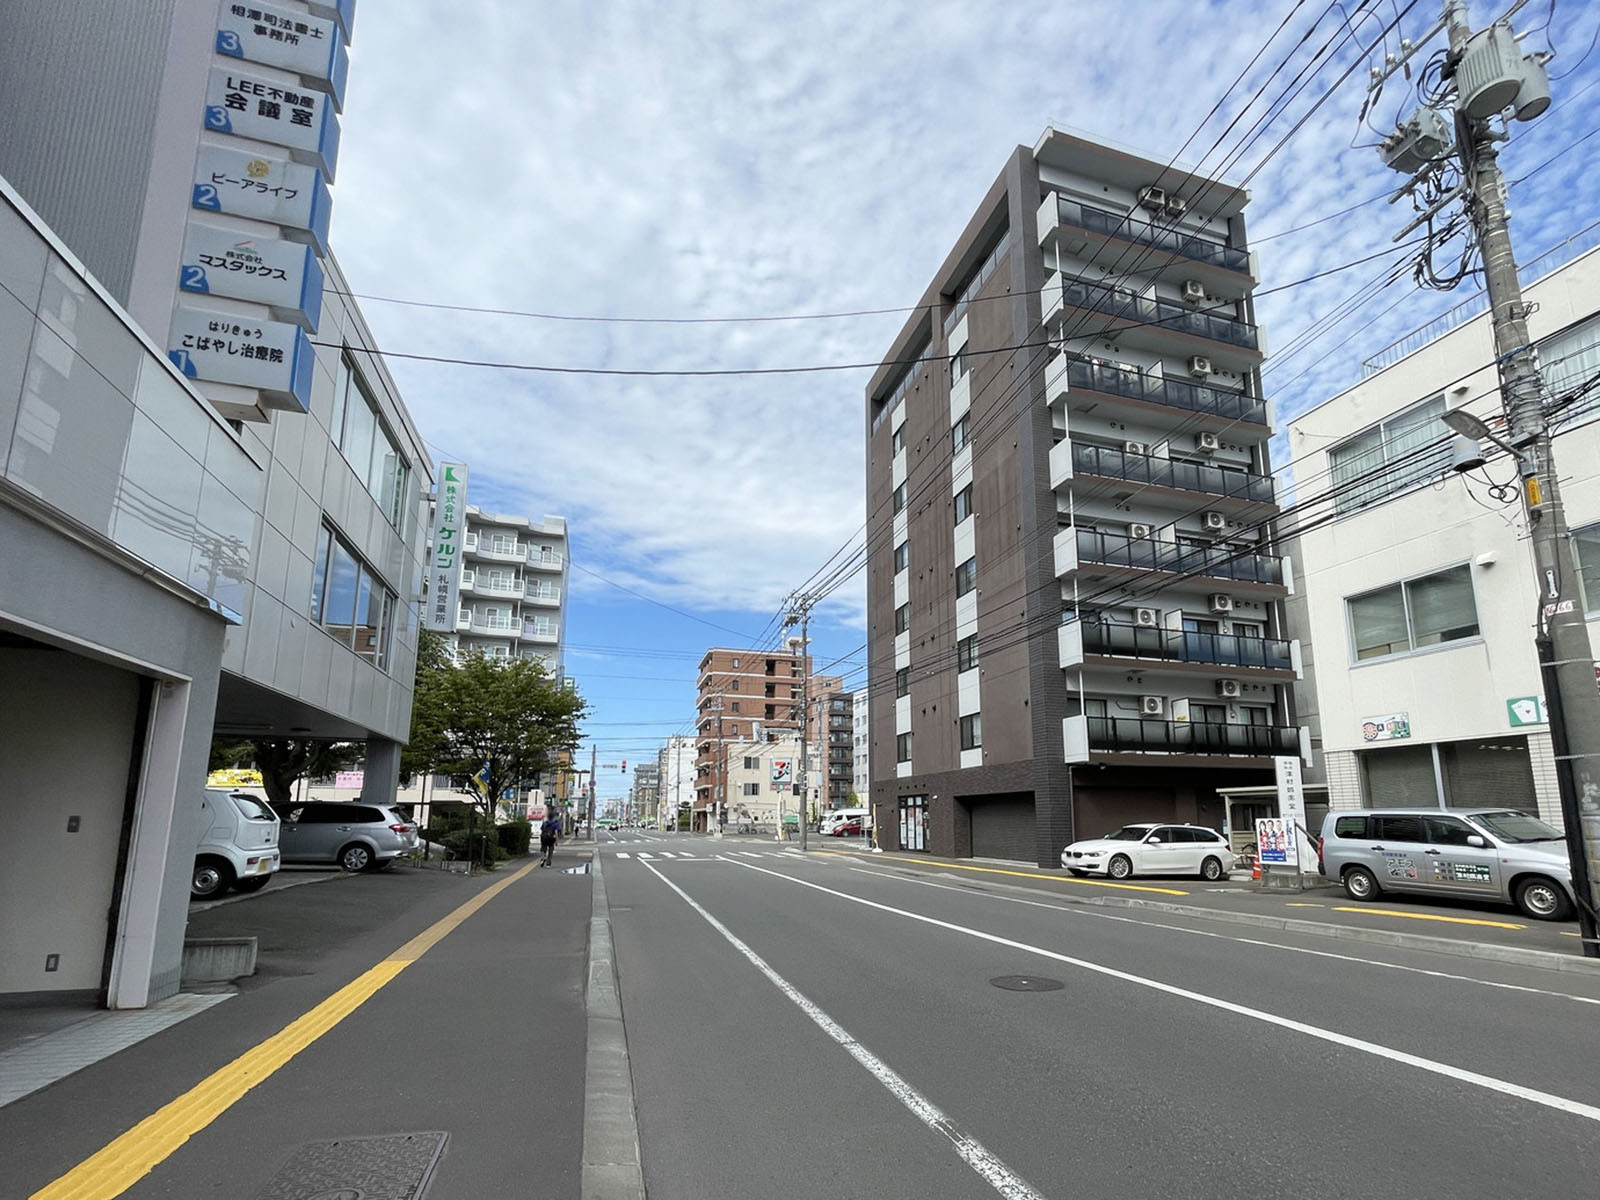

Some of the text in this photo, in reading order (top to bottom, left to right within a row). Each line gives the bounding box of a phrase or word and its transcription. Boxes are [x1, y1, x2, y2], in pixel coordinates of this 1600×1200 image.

[222, 32, 238, 51] 3
[253, 24, 300, 46] 事務所
[226, 77, 315, 110] LEE不動産
[210, 108, 226, 127] 3
[225, 92, 313, 128] 会議室
[198, 187, 214, 206] 2
[199, 254, 287, 281] マスタックス
[225, 250, 264, 265] 株式会社
[186, 267, 203, 287] 2
[208, 320, 263, 339] はりきゅう
[182, 334, 284, 364] こばやし治療院
[173, 352, 188, 373] 1
[443, 485, 456, 523] 株式会社
[437, 527, 457, 569] ケルン
[434, 573, 449, 625] 札幌営業所
